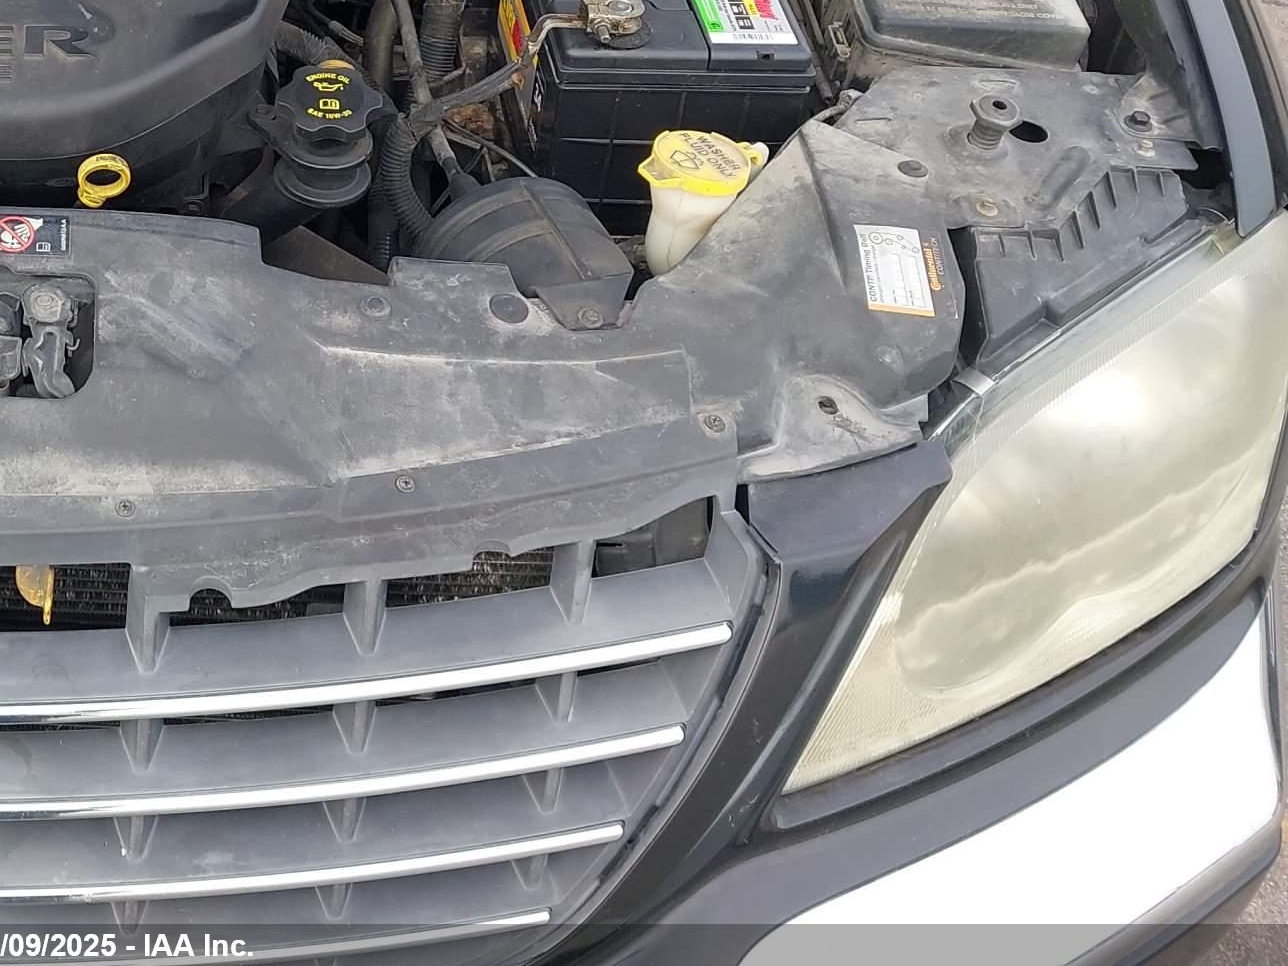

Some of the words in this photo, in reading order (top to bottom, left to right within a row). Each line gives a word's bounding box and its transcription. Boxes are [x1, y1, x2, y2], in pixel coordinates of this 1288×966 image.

[305, 72, 337, 82] ENGINE
[337, 75, 351, 85] OIL
[306, 107, 324, 118] SAE
[679, 132, 710, 159] FLUID
[707, 156, 737, 179] ONLY
[696, 134, 742, 171] WASHER
[923, 248, 942, 291] Continental
